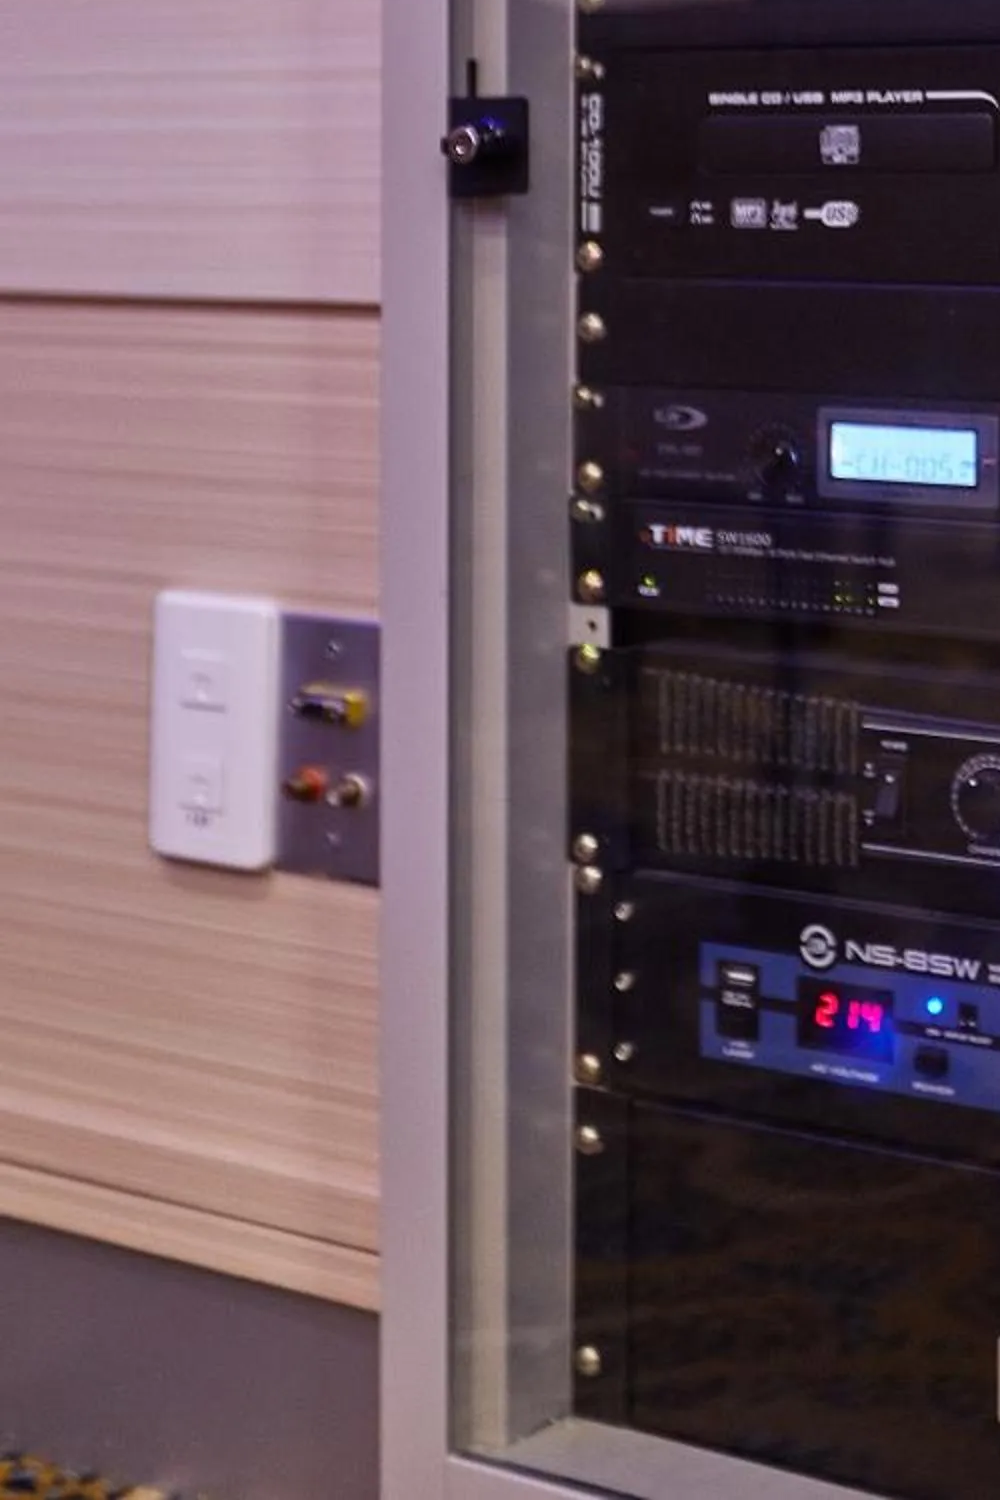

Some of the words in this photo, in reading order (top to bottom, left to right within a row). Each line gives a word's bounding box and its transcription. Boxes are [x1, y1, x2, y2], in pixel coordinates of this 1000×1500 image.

[709, 91, 758, 105] SINGLE
[866, 90, 924, 104] PLAYER
[814, 991, 883, 1033] 214
